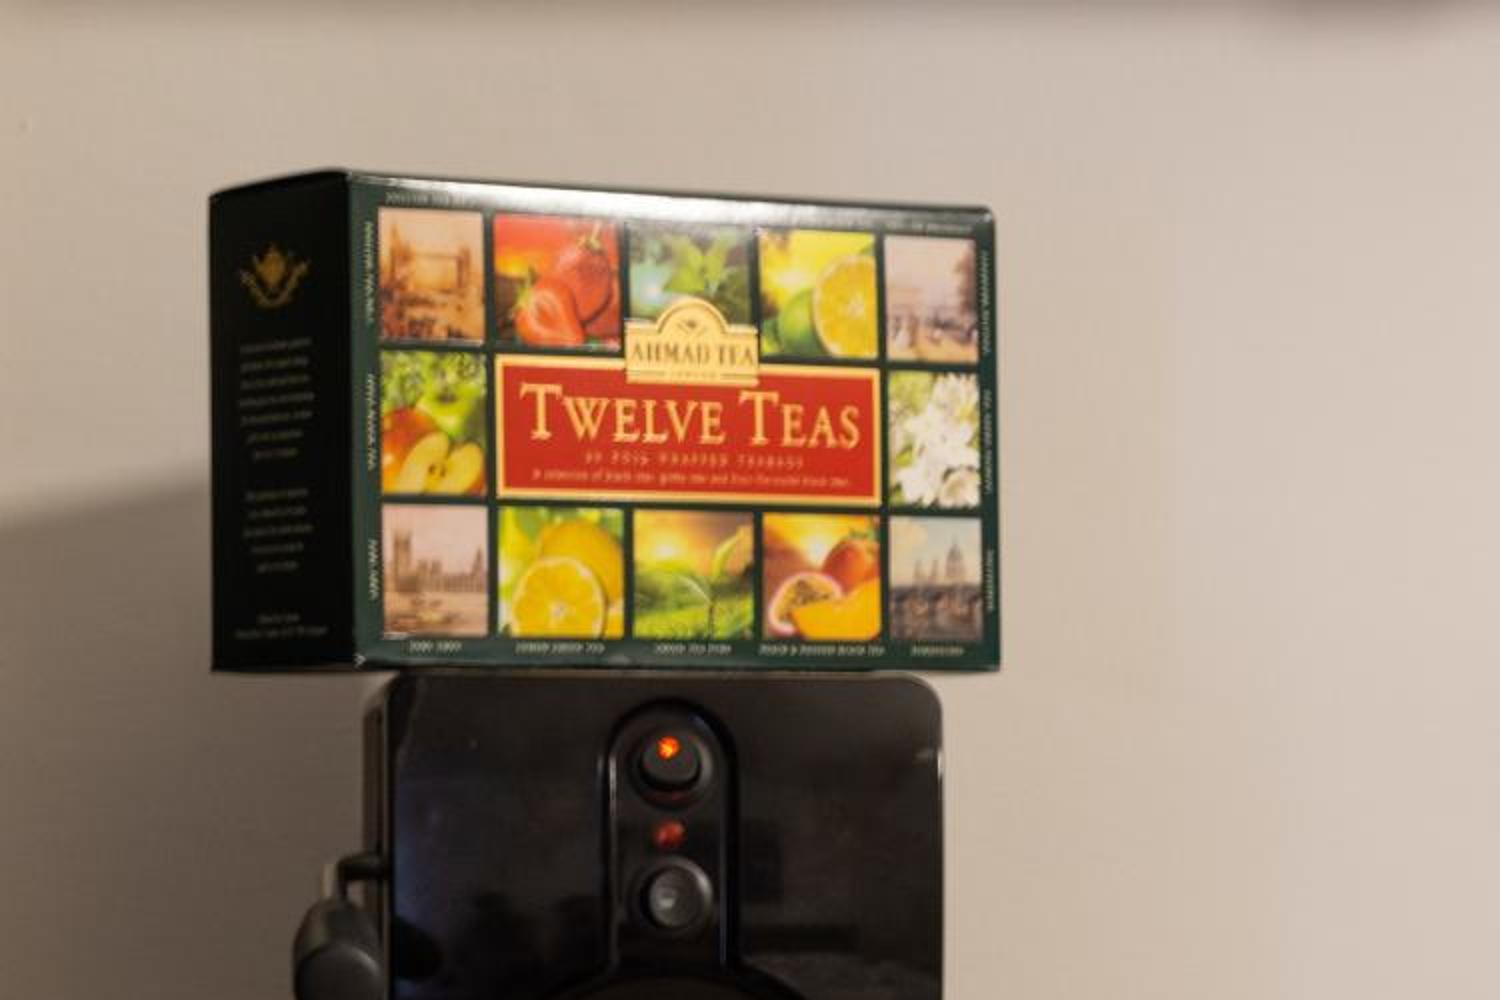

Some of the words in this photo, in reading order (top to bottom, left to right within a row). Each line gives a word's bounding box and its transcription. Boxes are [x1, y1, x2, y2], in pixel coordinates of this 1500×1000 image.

[630, 341, 711, 364] AHMAD
[717, 344, 755, 367] TEA
[519, 382, 726, 445] TWELVE
[738, 389, 860, 449] TEAS
